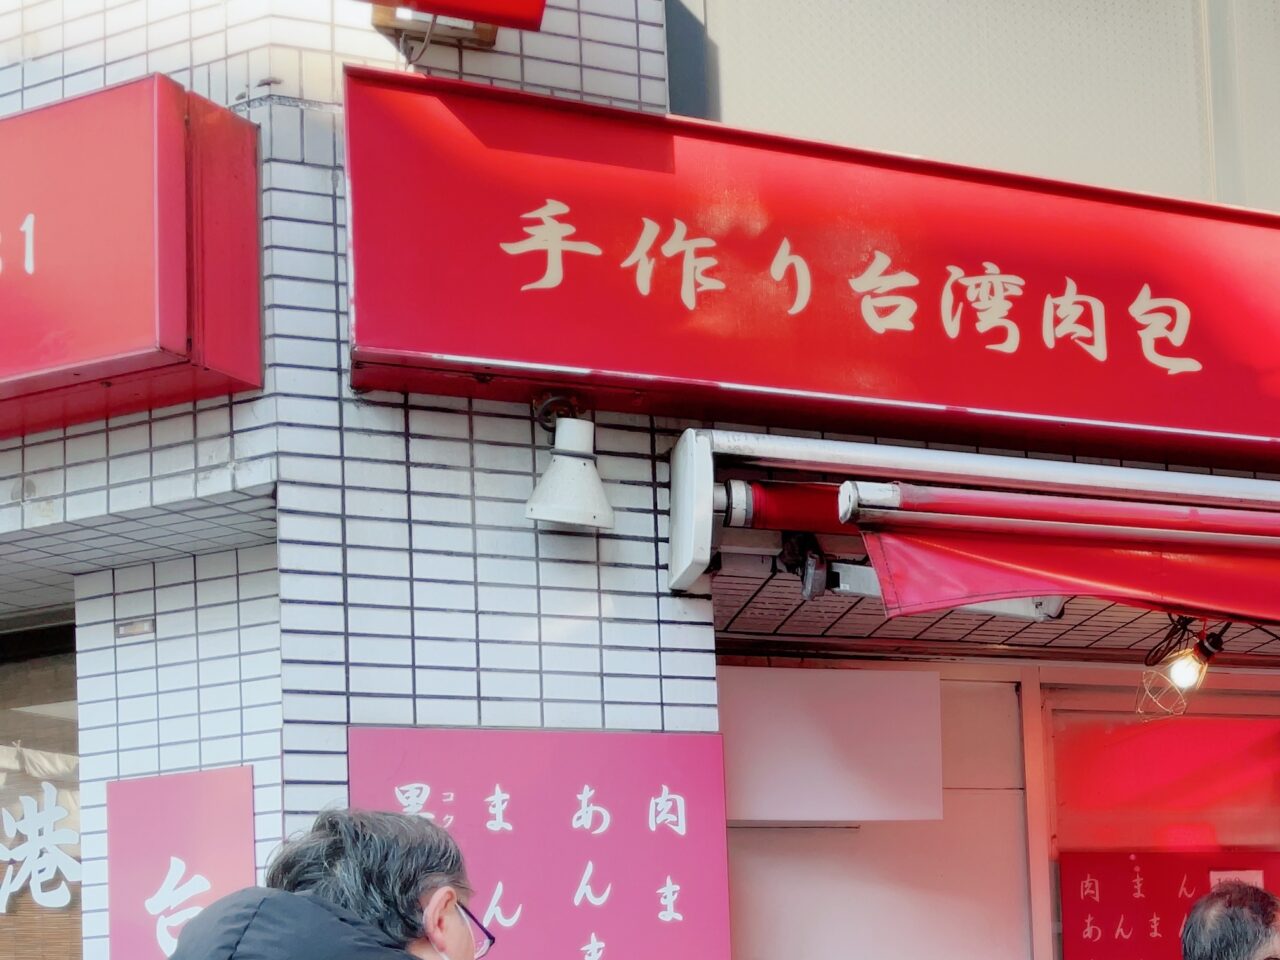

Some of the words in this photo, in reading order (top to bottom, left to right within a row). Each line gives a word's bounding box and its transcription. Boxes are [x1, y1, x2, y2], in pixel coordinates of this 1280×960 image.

[500, 199, 1203, 375] 手作り台湾肉包
[1081, 874, 1195, 902] 肉まん
